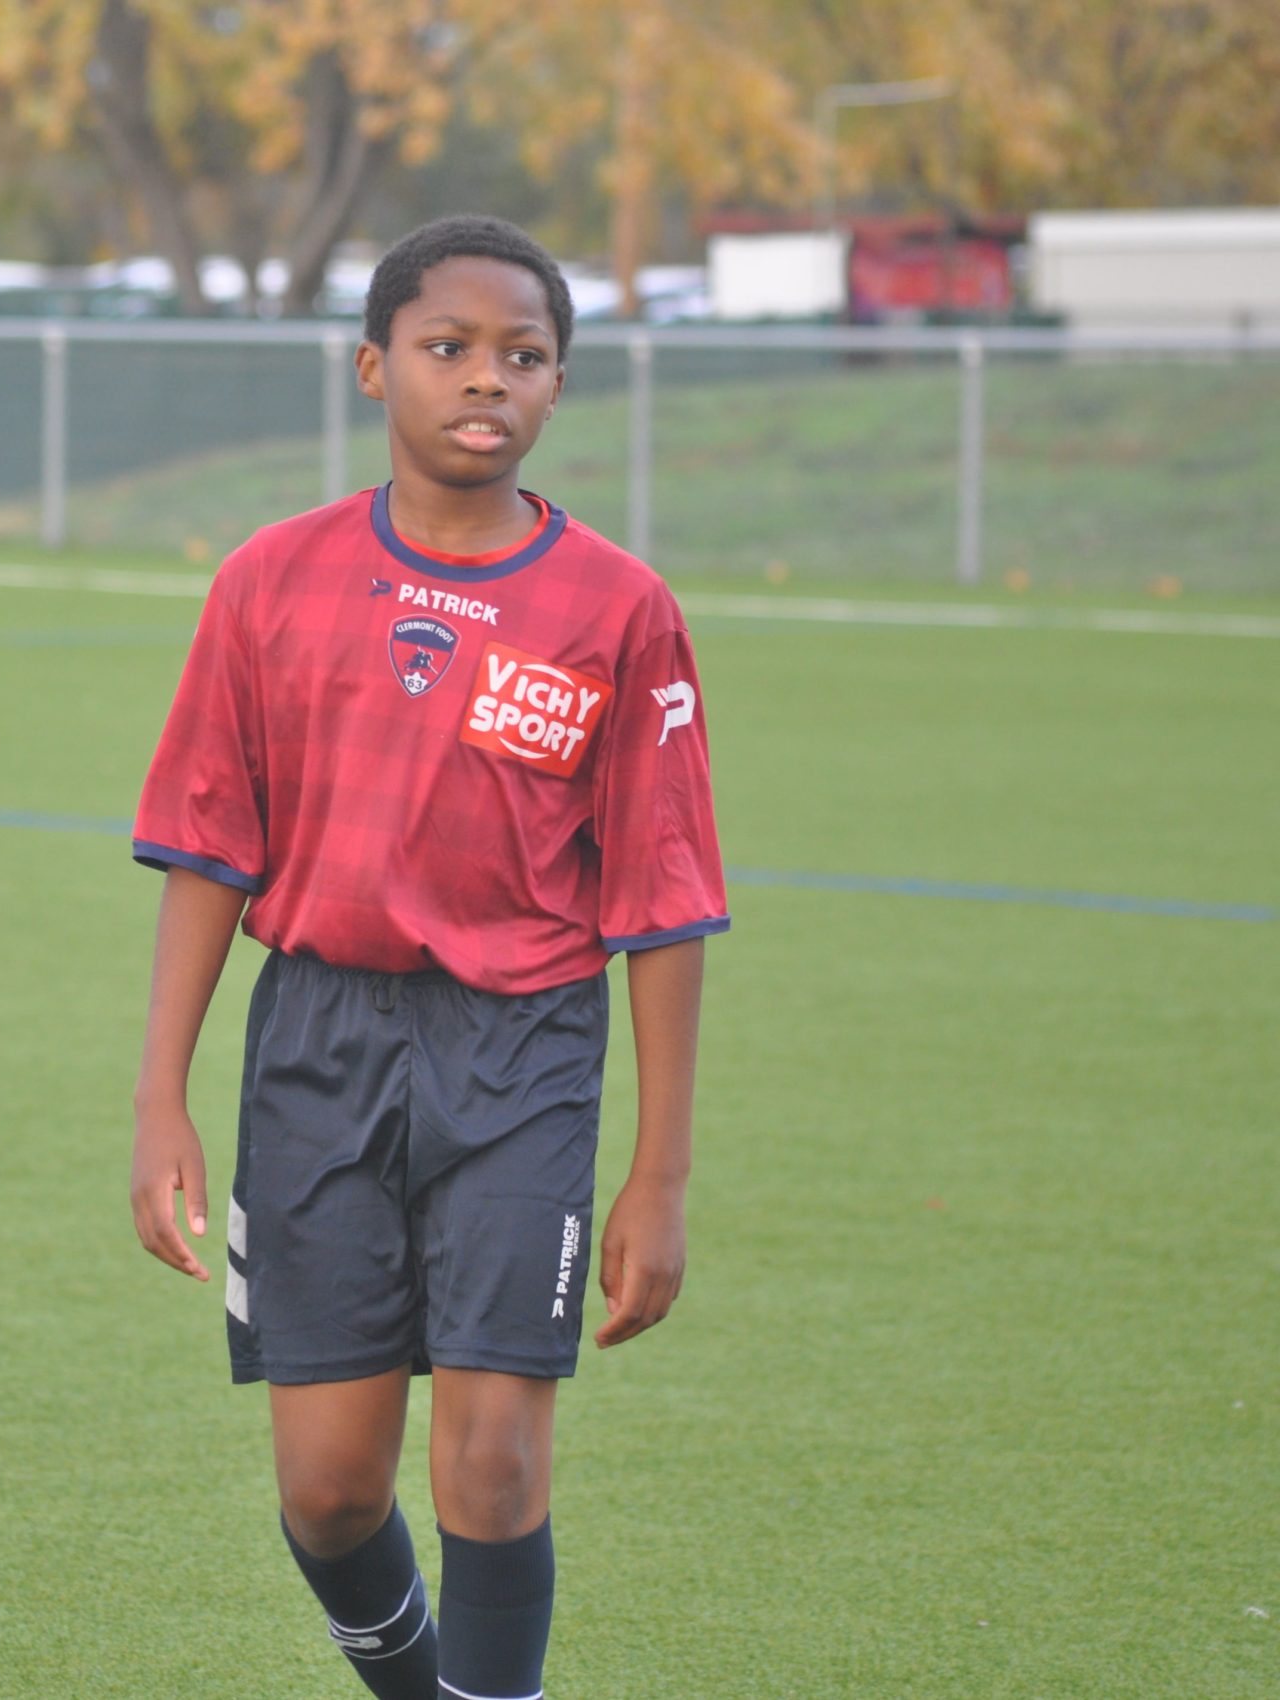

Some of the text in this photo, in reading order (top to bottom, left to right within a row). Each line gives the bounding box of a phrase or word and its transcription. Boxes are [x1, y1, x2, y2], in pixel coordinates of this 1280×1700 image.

[398, 583, 501, 625] PATRICK
[396, 621, 455, 643] CLERMONT FOOT
[407, 678, 423, 690] 63
[487, 653, 600, 724] VICHY
[469, 696, 585, 761] SPORT
[555, 1213, 577, 1294] PATRICK
